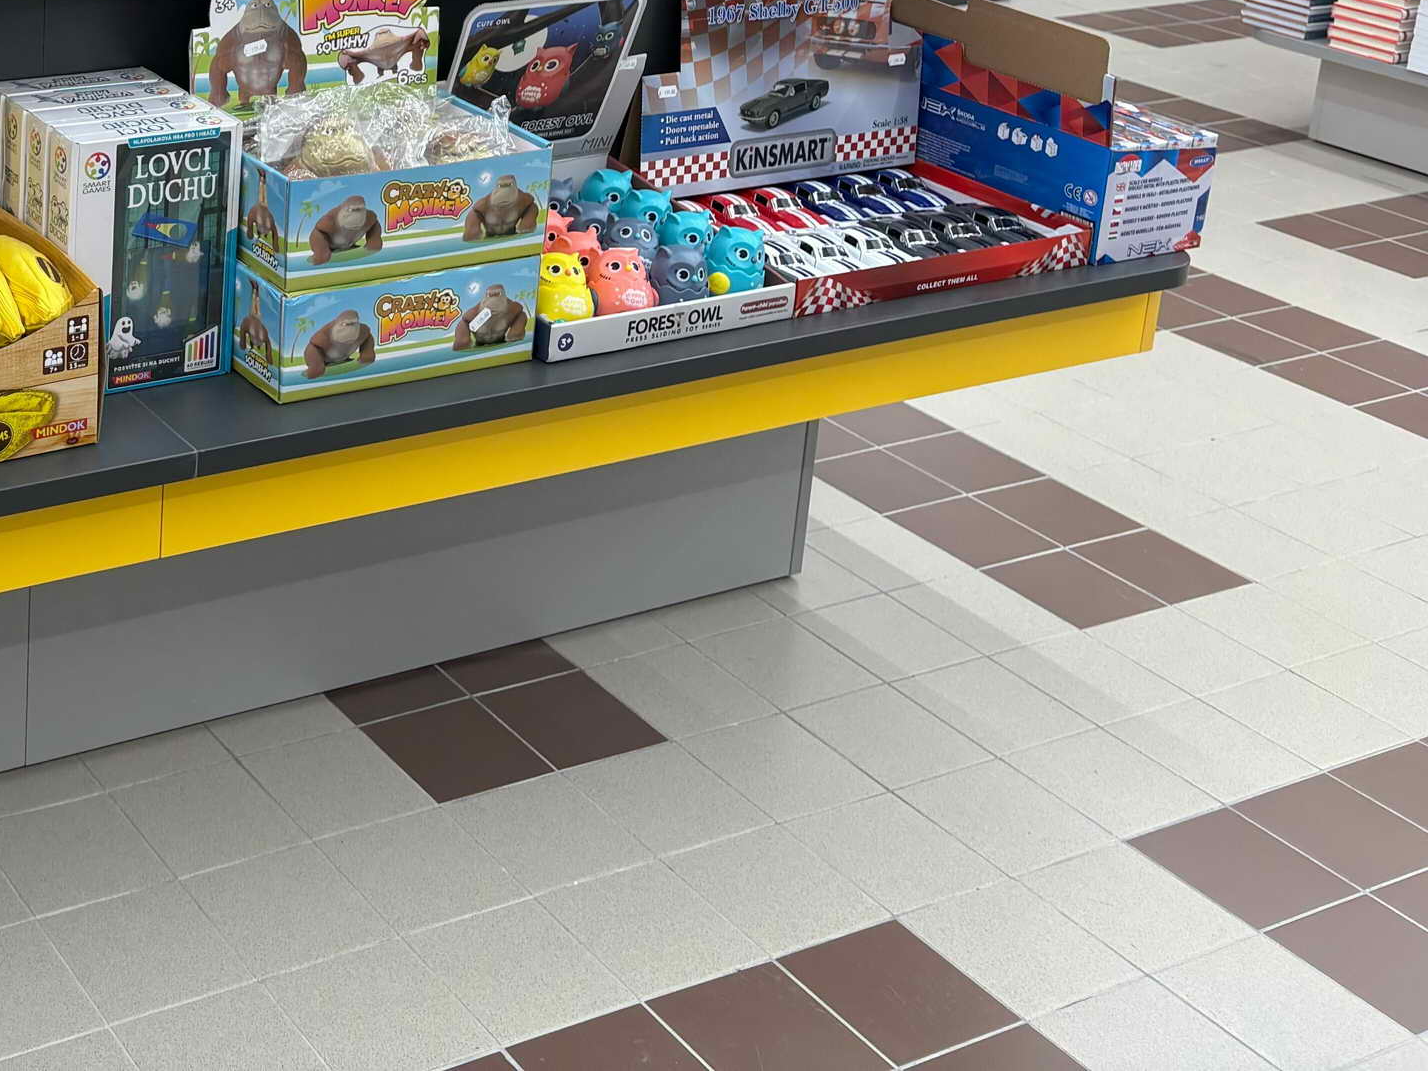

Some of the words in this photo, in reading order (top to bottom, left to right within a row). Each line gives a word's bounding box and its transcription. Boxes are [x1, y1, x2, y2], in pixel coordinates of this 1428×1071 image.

[708, 5, 744, 25] 1967
[749, 2, 799, 21] Shelby
[316, 33, 370, 55] SQUISHY!
[666, 125, 687, 135] Doors
[688, 122, 719, 133] openable
[136, 147, 212, 179] LOVCI
[127, 172, 218, 209] DUCHŮ
[387, 198, 471, 231] MONKEY
[917, 281, 942, 291] COLLECT
[945, 278, 963, 287] THEM
[966, 274, 978, 284] ALL
[379, 308, 462, 342] MONKEY
[626, 334, 650, 344] PRESS
[652, 330, 682, 340] SLIDING
[685, 327, 699, 335] TOY
[701, 323, 722, 332] SERIES
[628, 312, 684, 336] FOREST
[688, 307, 723, 327] OWL
